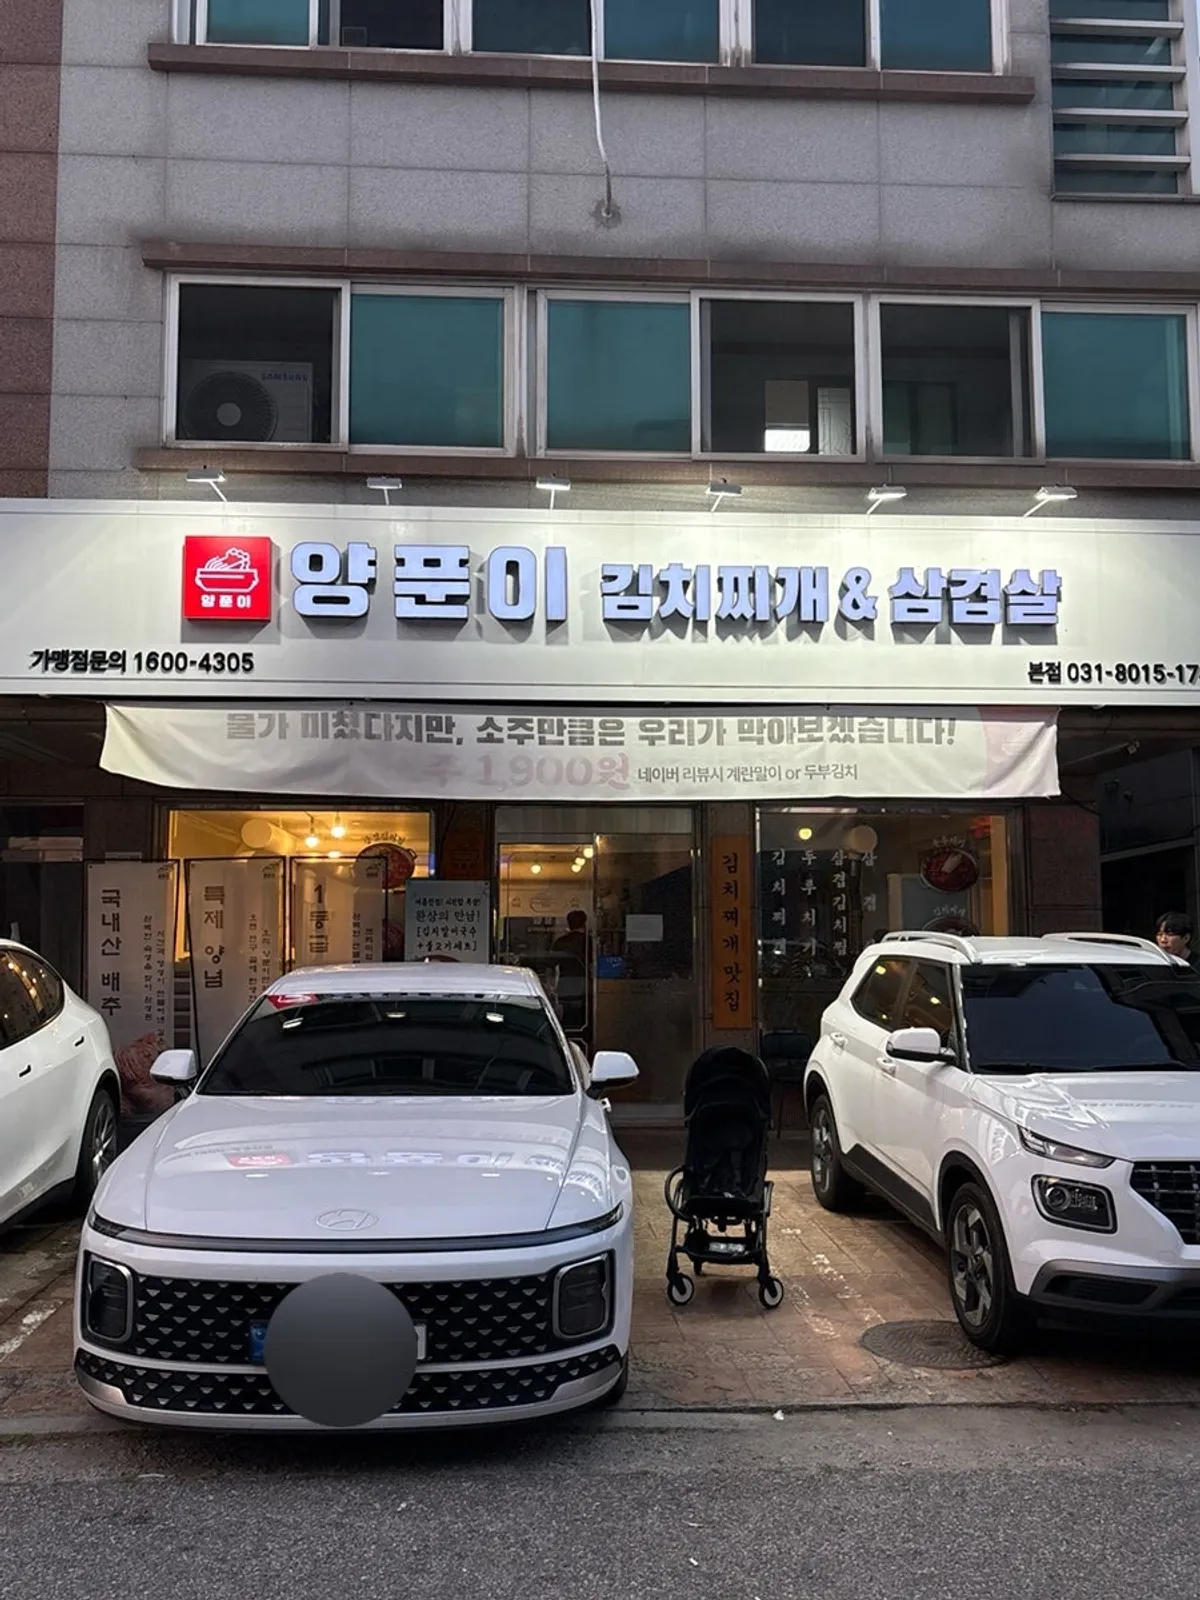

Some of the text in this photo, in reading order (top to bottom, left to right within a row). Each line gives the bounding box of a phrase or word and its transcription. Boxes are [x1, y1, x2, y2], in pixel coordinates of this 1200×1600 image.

[290, 541, 568, 622] 양푼이
[200, 594, 252, 609] 양푼이
[30, 649, 255, 674] 가맹점문의 1600-4305
[1028, 661, 1200, 685] 본점 031-8015-17
[226, 713, 290, 739] 물가
[477, 716, 625, 746] 소주만큼은
[638, 718, 727, 747] 우리가
[737, 716, 956, 746] 막아보겠습니다!
[476, 752, 632, 792] 1,900원
[637, 763, 859, 783] 네이버 리뷰시 계란말이 or 두부김치
[203, 885, 225, 989] 특제 양념
[721, 851, 743, 1012] 김치찌개맛집
[101, 889, 122, 1016] 국내산 배추
